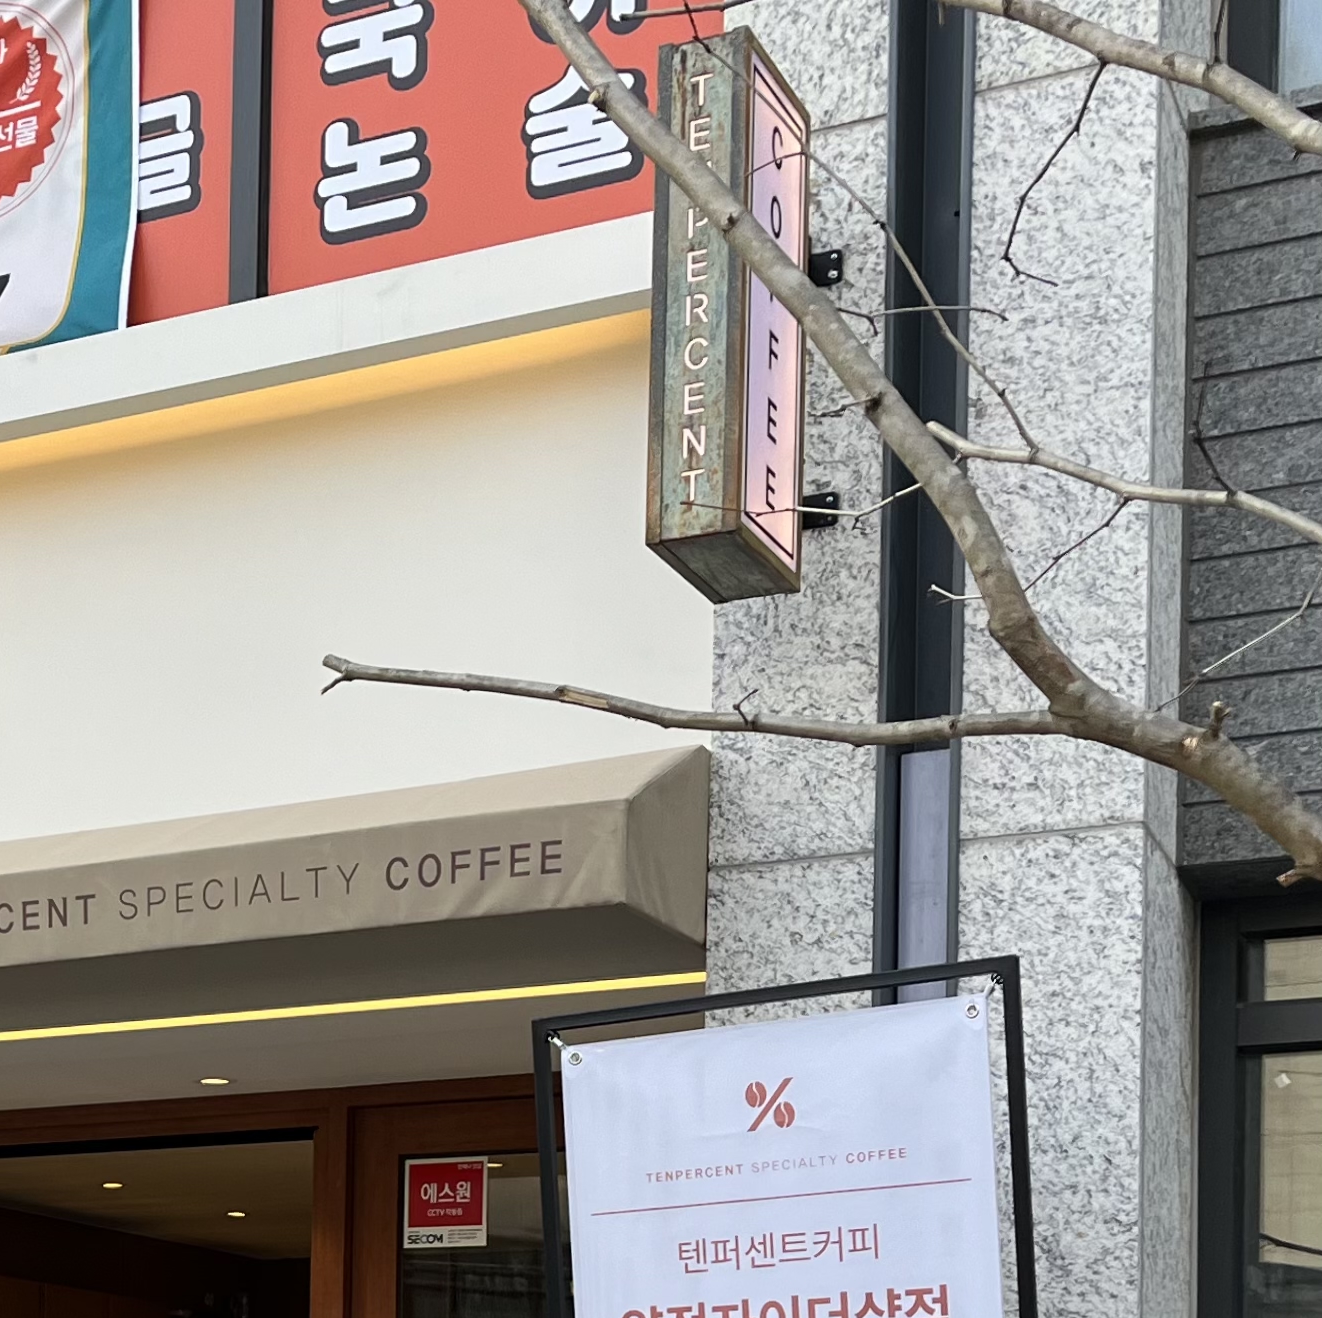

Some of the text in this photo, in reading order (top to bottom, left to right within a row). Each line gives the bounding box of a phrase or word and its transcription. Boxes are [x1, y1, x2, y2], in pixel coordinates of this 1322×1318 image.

[683, 72, 715, 506] TEPERCENT
[763, 125, 785, 513] COFEE
[118, 862, 360, 920] SPECIALTY
[384, 839, 564, 892] COFFEE
[419, 1181, 471, 1204] 에스원
[645, 1147, 908, 1184] TENPERCENT SPECIALTY COFFEE
[678, 1222, 880, 1275] 텐퍼센트커피
